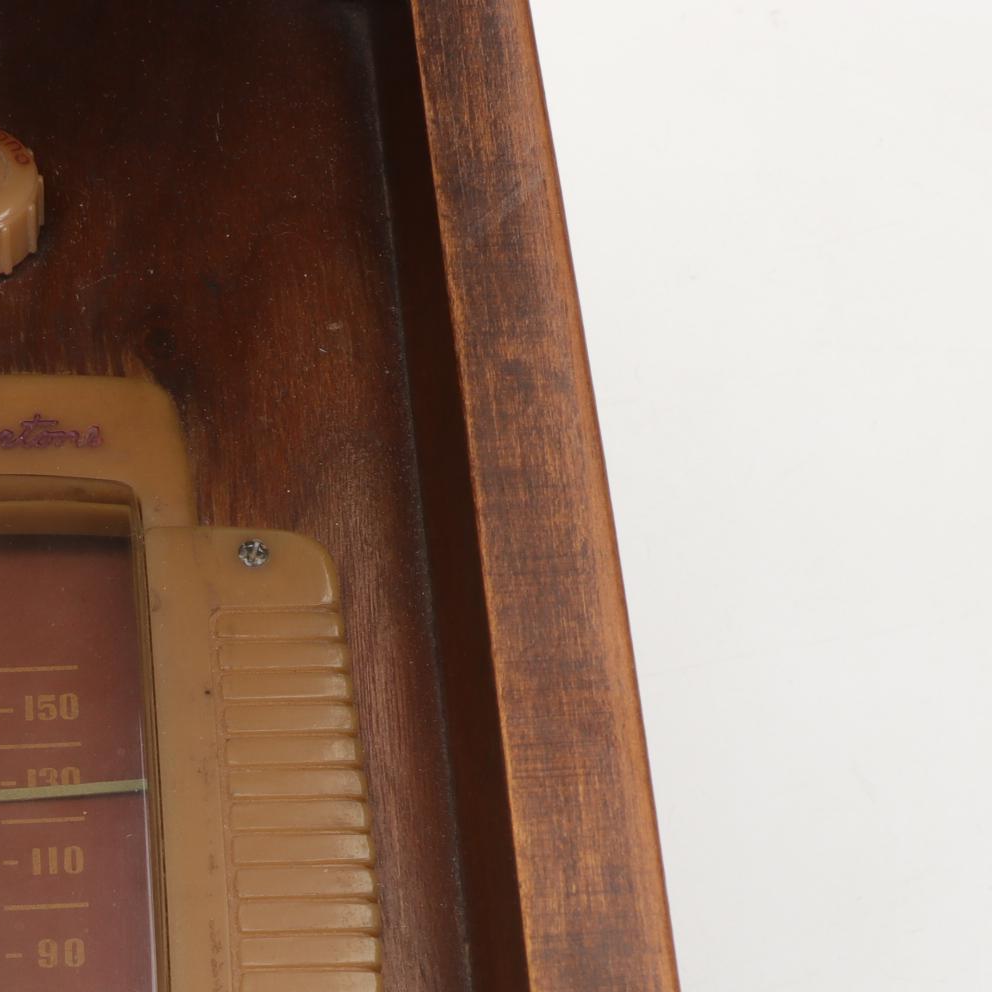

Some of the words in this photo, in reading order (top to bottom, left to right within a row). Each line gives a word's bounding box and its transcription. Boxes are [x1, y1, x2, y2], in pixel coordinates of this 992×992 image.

[24, 692, 80, 721] 150
[31, 845, 85, 875] 110
[37, 938, 86, 968] 90
